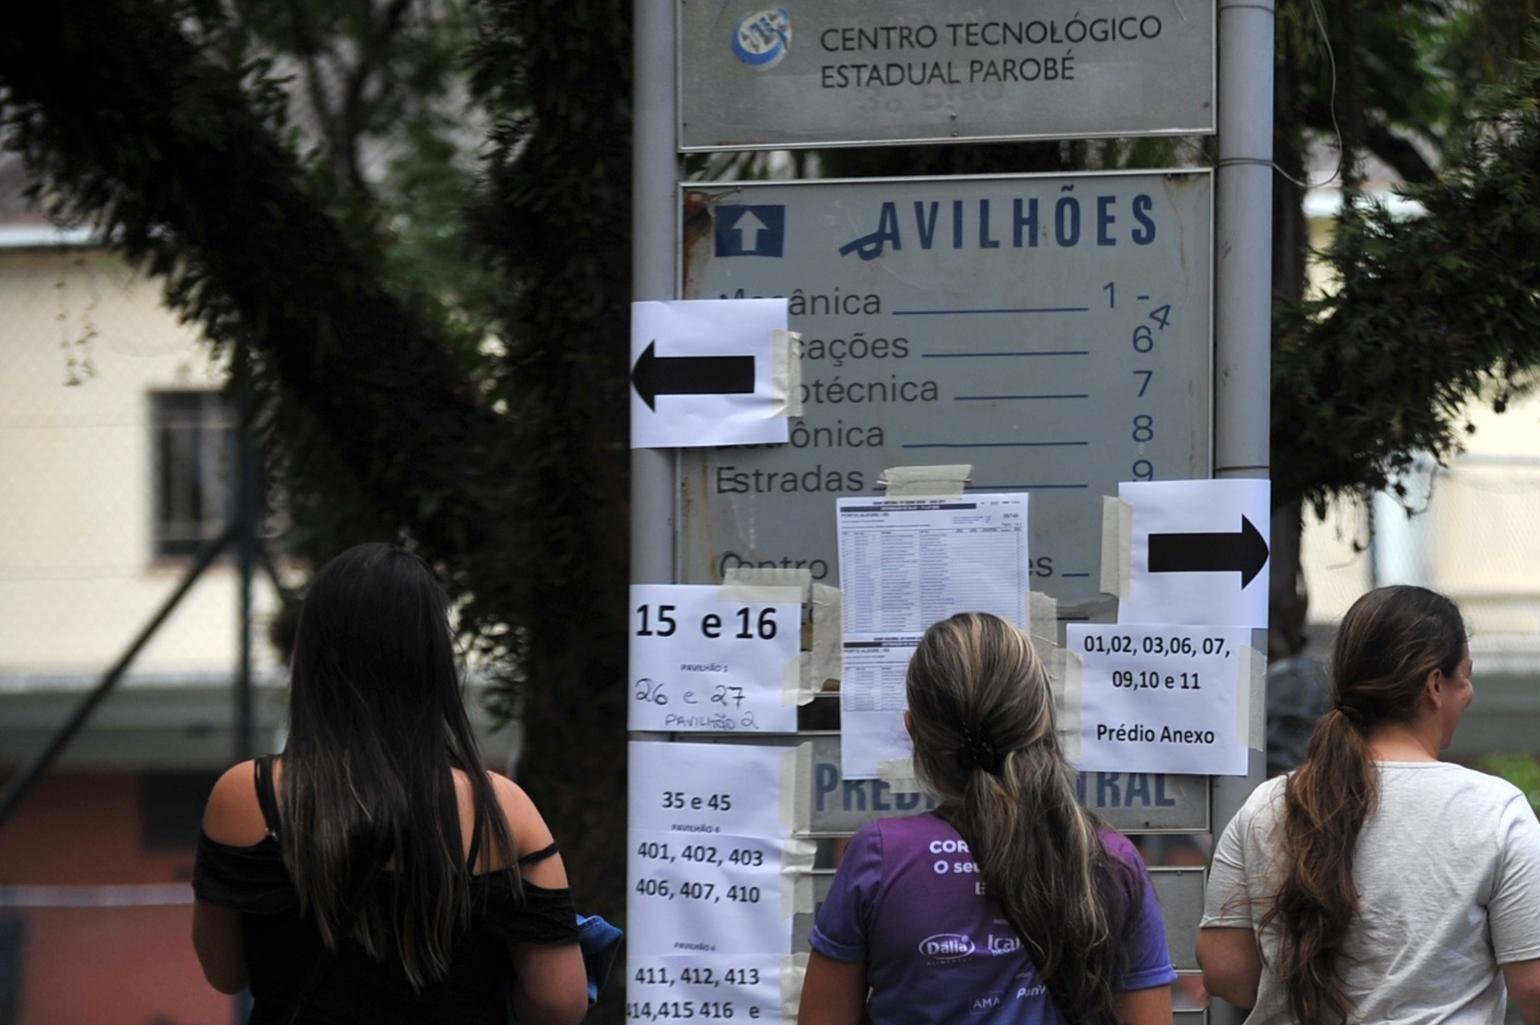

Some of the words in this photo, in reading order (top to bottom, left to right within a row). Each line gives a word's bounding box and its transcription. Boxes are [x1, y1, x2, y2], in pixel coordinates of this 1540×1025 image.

[820, 24, 938, 52] CENTRO
[946, 13, 1162, 48] TECNOLÓGICO
[821, 63, 960, 89] ESTADUAL
[969, 50, 1075, 85] PAROBÉ
[1103, 281, 1115, 309] 1
[1149, 304, 1172, 330] 4
[1132, 325, 1154, 353] 6
[1132, 371, 1153, 398] 7
[1132, 415, 1154, 443] 8
[717, 464, 864, 495] Estradas
[1132, 460, 1154, 482] 9
[635, 604, 677, 637] 15
[701, 612, 722, 638] e
[735, 607, 777, 640] 16
[1083, 635, 1138, 656] 01,02,
[1142, 637, 1197, 657] 03,06,
[1202, 638, 1231, 658] 07,
[1112, 670, 1160, 691] 09,10
[1164, 675, 1175, 689] e
[1180, 673, 1201, 689] 11
[635, 678, 668, 705] 26
[711, 685, 746, 709] 27
[741, 710, 760, 730] 2
[1096, 723, 1155, 742] Prédio
[1159, 725, 1215, 744] Anexo
[662, 791, 685, 809] 35
[690, 797, 702, 810] e
[707, 794, 732, 811] 45
[637, 842, 676, 863] 401,
[681, 845, 723, 867] 402,
[728, 849, 764, 866] 403
[929, 840, 970, 854] COR
[933, 860, 949, 874] O
[635, 878, 674, 900] 406,
[679, 881, 720, 903] 407,
[726, 886, 760, 903] 410
[635, 968, 675, 987] 411,
[680, 968, 719, 987] 412,
[724, 968, 760, 985] 413
[700, 1002, 734, 1018] 416
[749, 1005, 760, 1018] e
